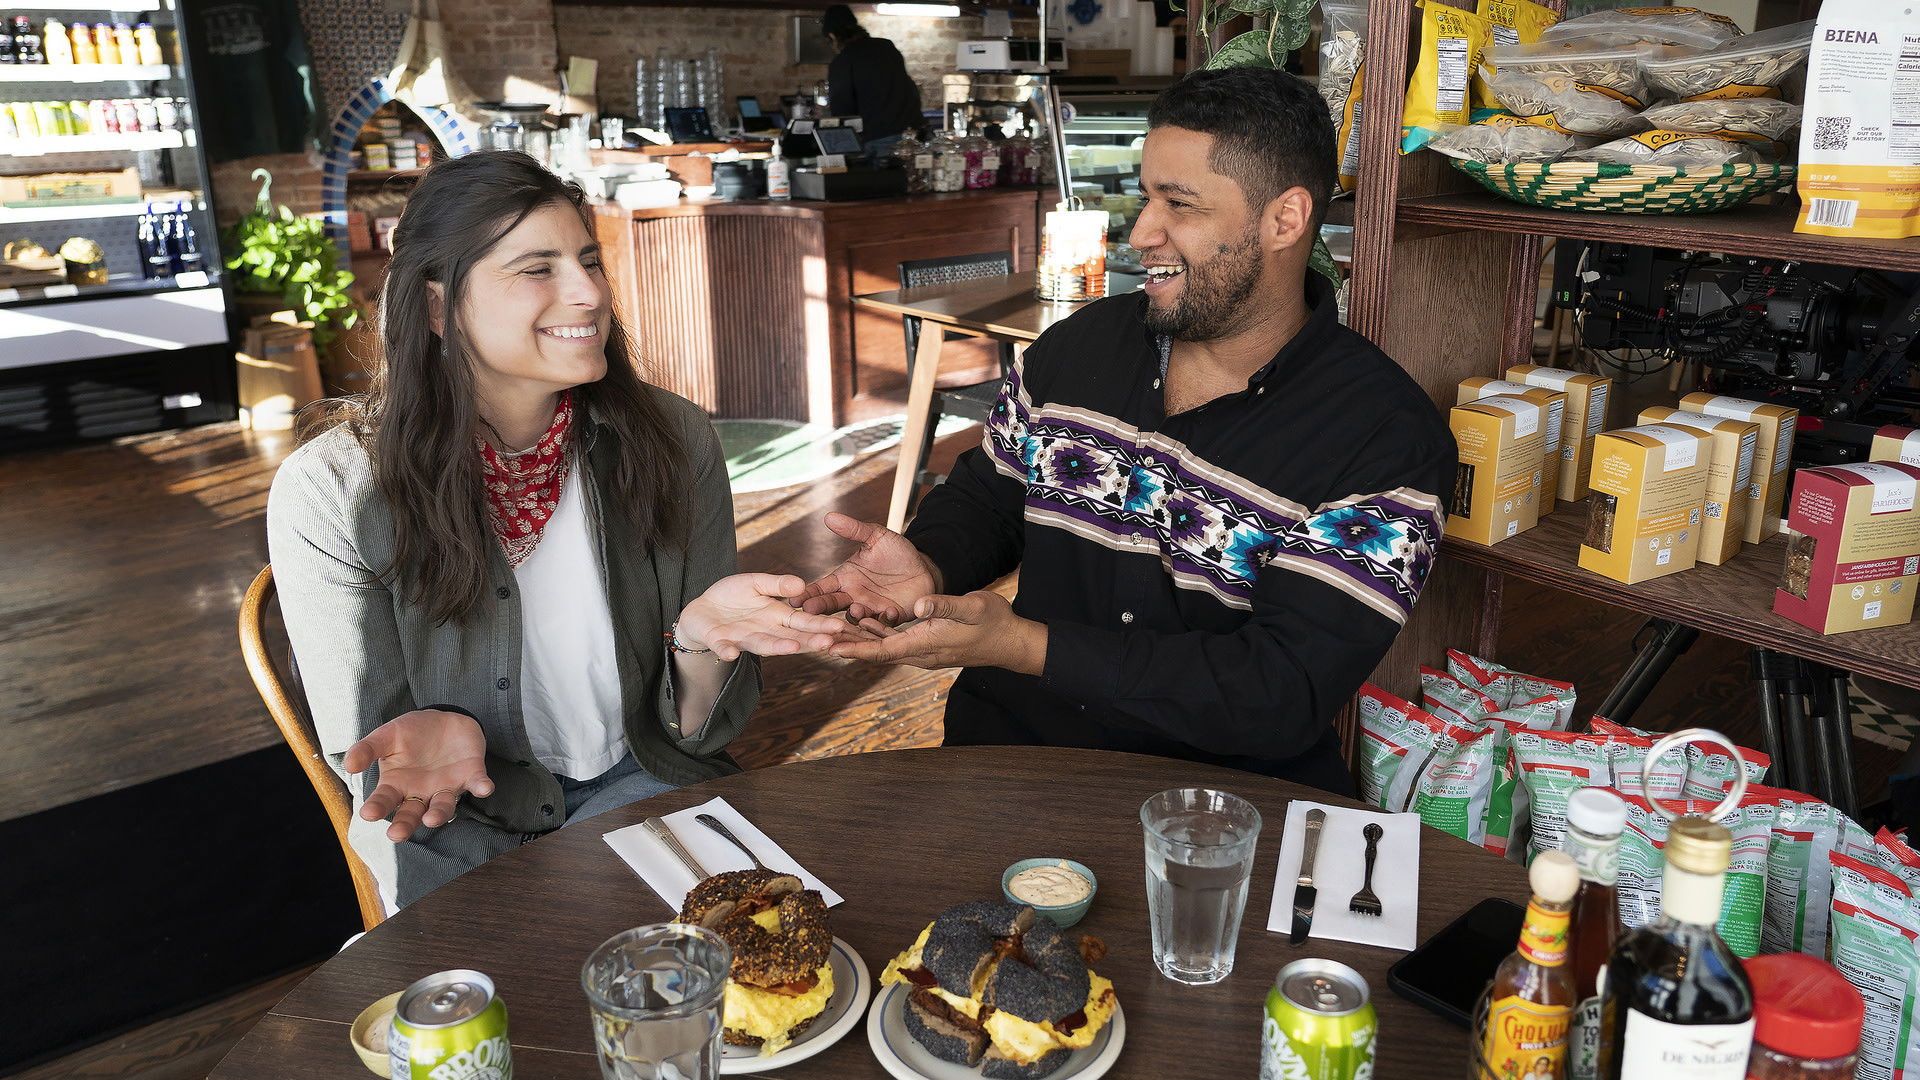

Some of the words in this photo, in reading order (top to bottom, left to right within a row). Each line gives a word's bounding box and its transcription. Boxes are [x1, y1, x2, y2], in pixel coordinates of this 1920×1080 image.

[1824, 29, 1878, 44] BIENA
[1848, 874, 1867, 884] MILPA
[1884, 889, 1902, 900] MILPA
[1837, 959, 1864, 976] Nutrition
[1865, 972, 1885, 982] Facts
[1504, 1016, 1565, 1043] CHOLUL
